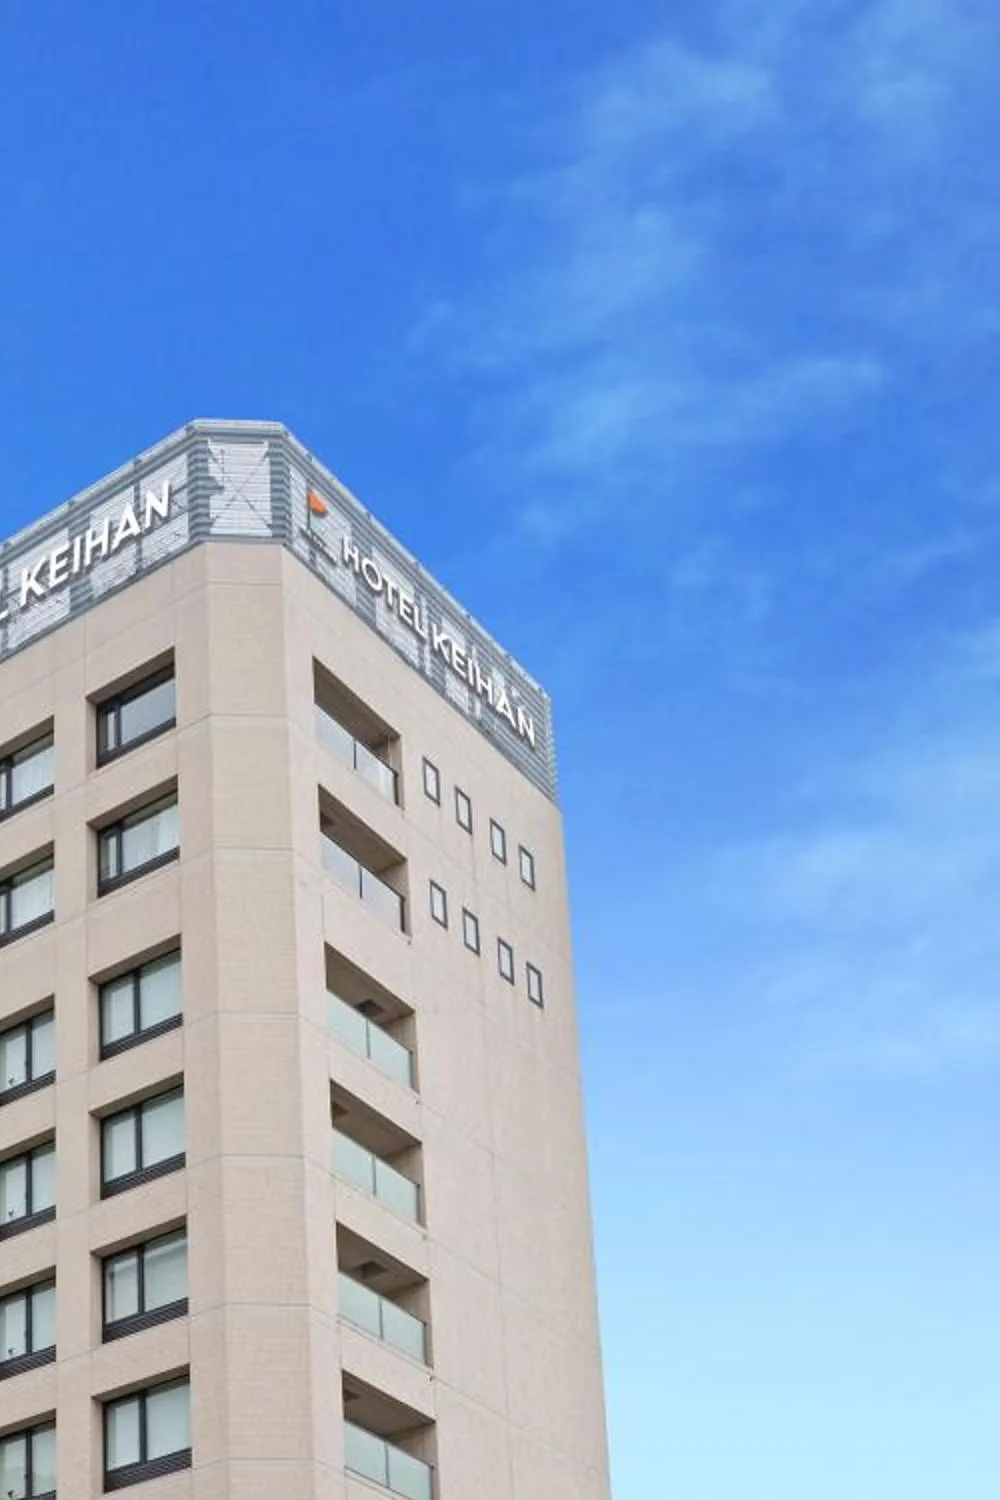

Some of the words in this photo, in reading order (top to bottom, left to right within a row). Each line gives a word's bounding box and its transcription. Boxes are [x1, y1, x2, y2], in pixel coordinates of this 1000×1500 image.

[19, 480, 172, 608] KEIHAN
[341, 535, 427, 640] HOTEL
[431, 623, 536, 748] KEIHAN
